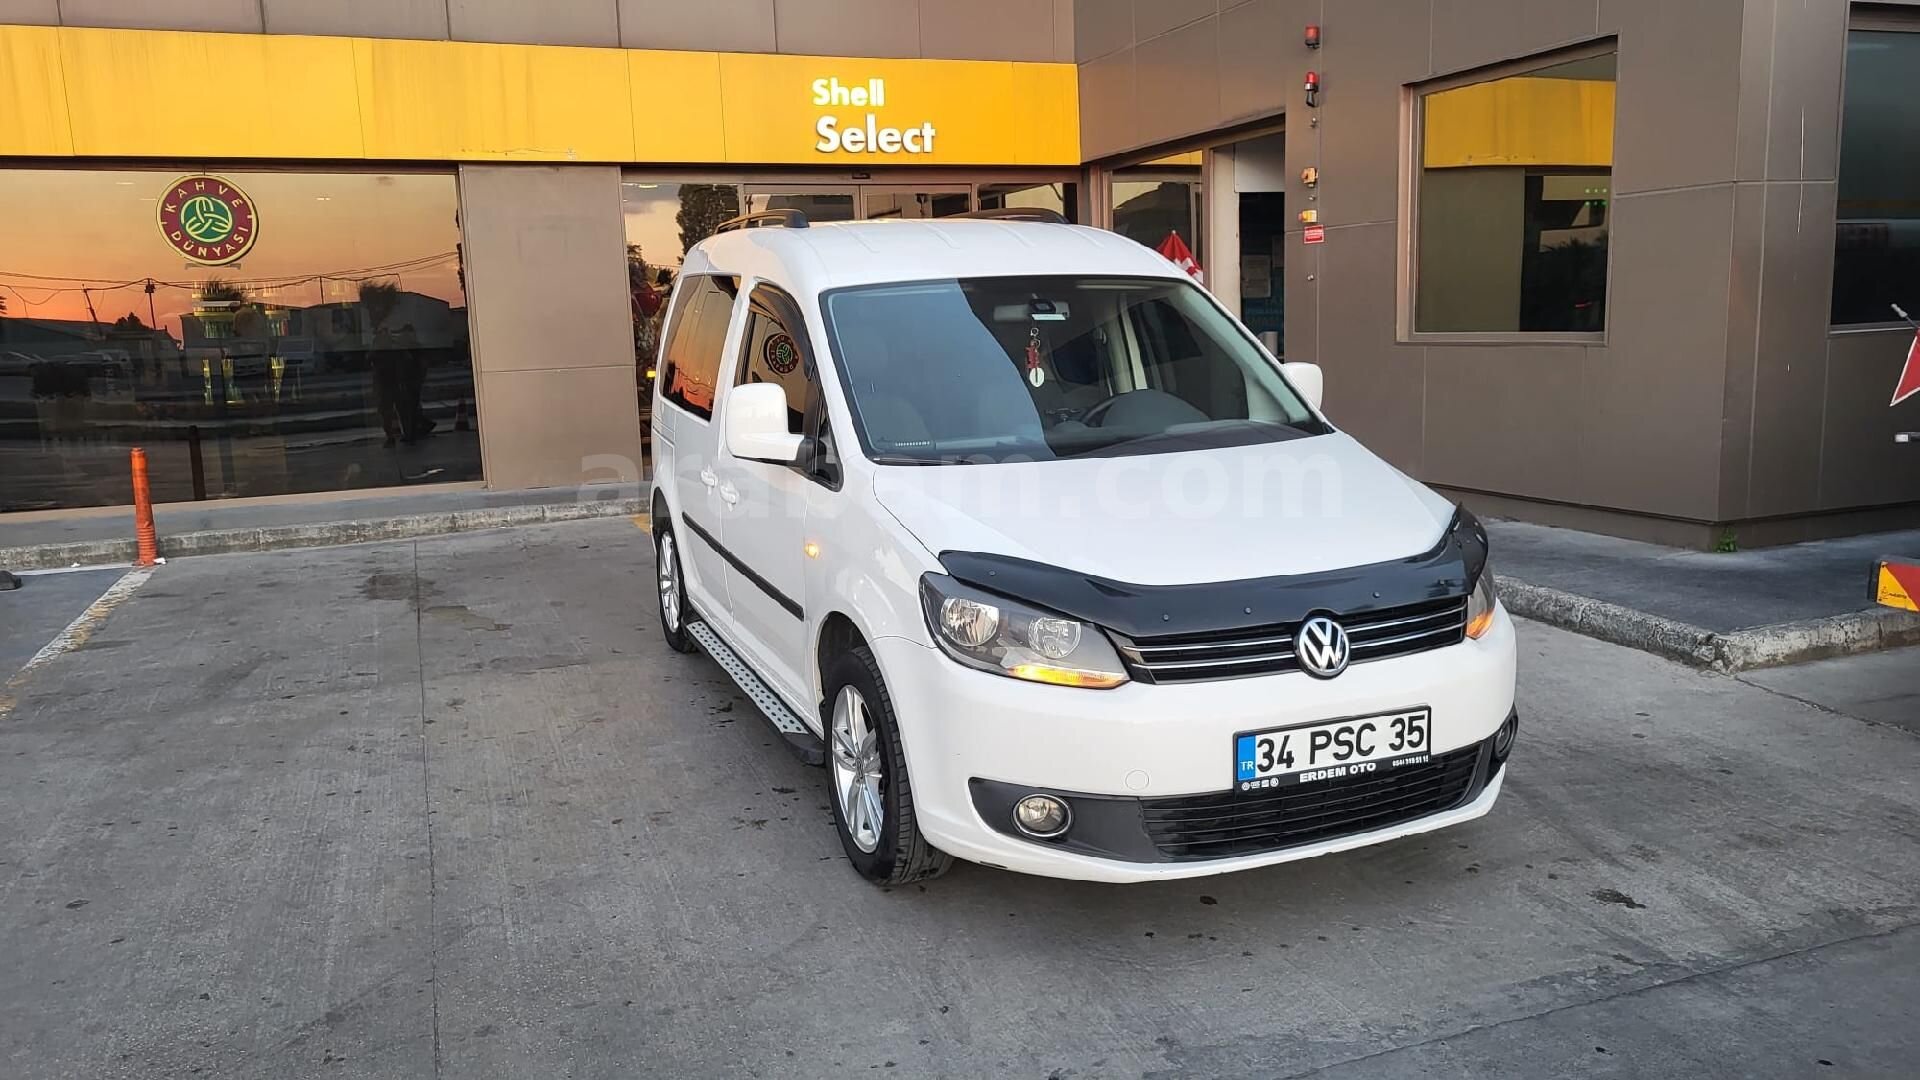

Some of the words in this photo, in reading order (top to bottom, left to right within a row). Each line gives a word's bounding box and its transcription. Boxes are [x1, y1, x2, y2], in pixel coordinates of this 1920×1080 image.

[812, 77, 885, 107] Shell
[815, 113, 936, 153] Select
[165, 181, 243, 213] KAHVE
[171, 226, 249, 257] DÜNYASI
[1256, 735, 1294, 773] 34
[1309, 723, 1377, 765] PSC
[1388, 714, 1426, 751] 35
[1240, 760, 1254, 771] TR
[1299, 764, 1347, 783] ERDEM
[1349, 762, 1377, 775] OTO
